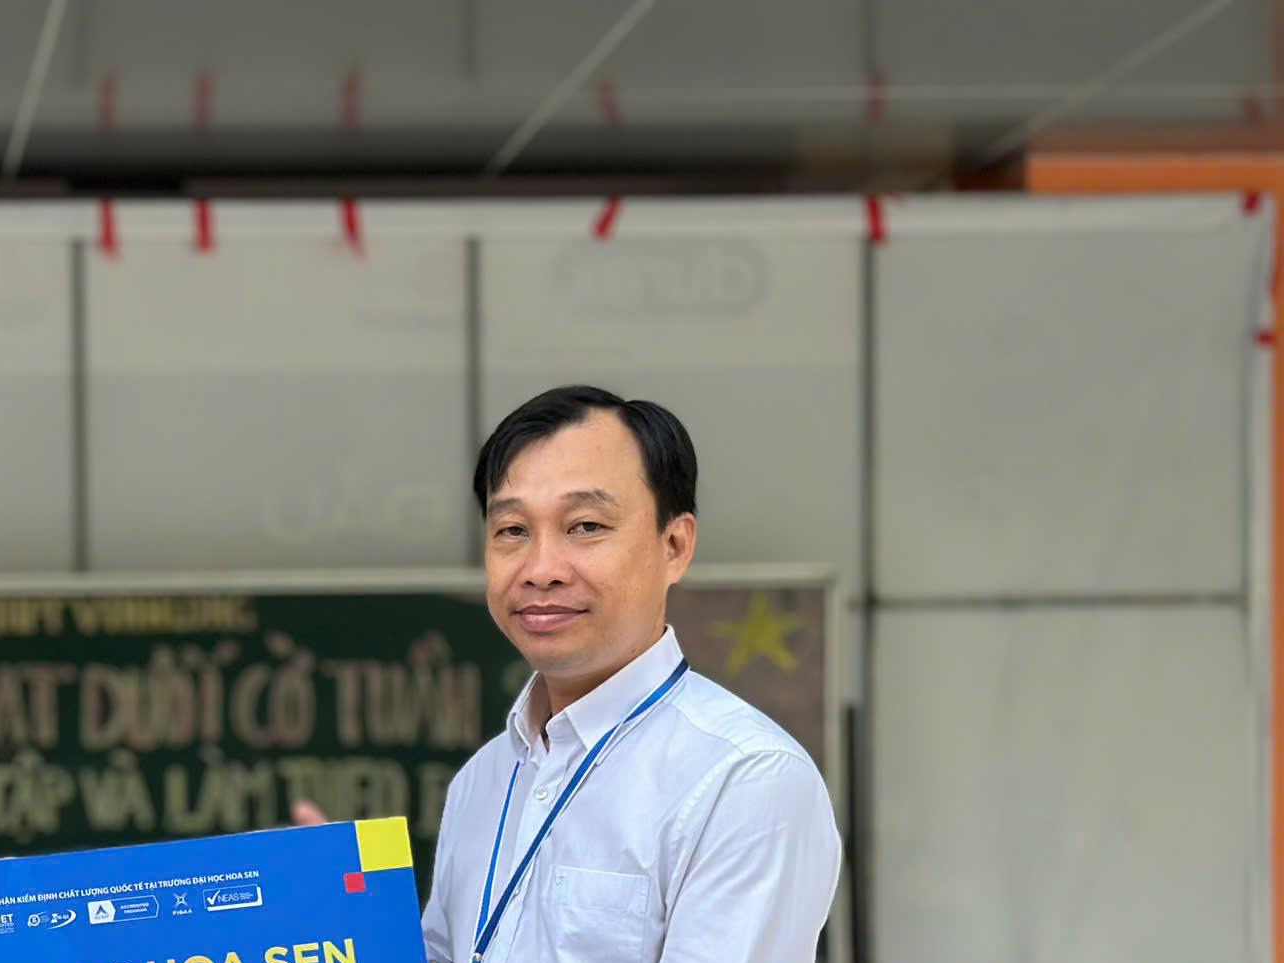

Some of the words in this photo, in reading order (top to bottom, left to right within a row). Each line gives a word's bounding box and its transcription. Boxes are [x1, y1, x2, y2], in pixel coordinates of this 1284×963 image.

[225, 871, 244, 881] HOA
[243, 870, 260, 879] SEN
[217, 892, 240, 903] NEAS
